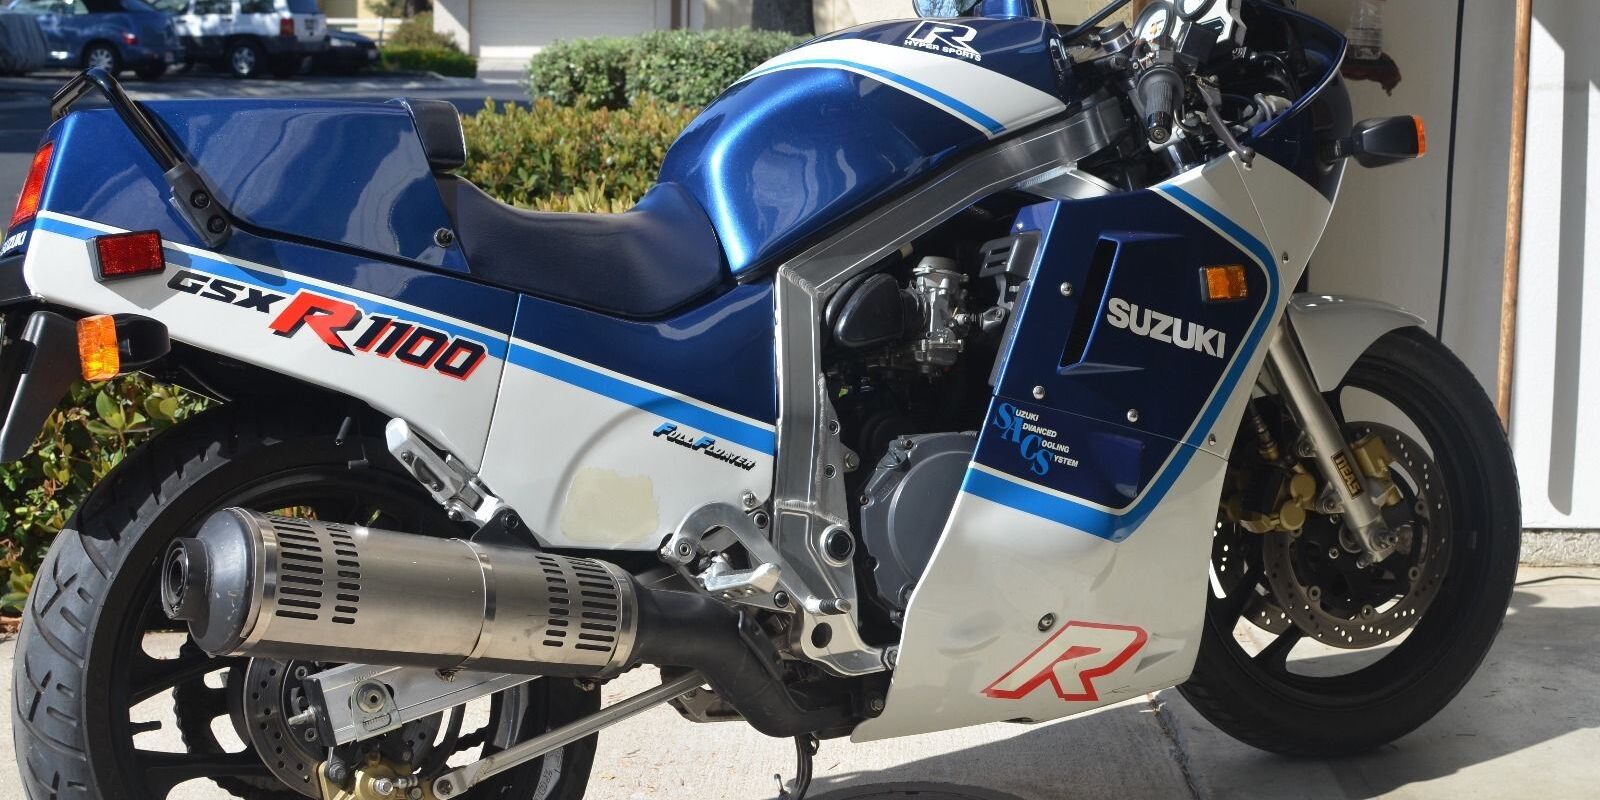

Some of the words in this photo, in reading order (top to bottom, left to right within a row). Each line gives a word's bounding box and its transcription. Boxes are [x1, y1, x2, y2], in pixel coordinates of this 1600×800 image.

[903, 39, 940, 52] HYPER
[942, 46, 982, 62] SPORTS
[1106, 297, 1226, 359] SUZUKI
[980, 620, 1148, 702] R
